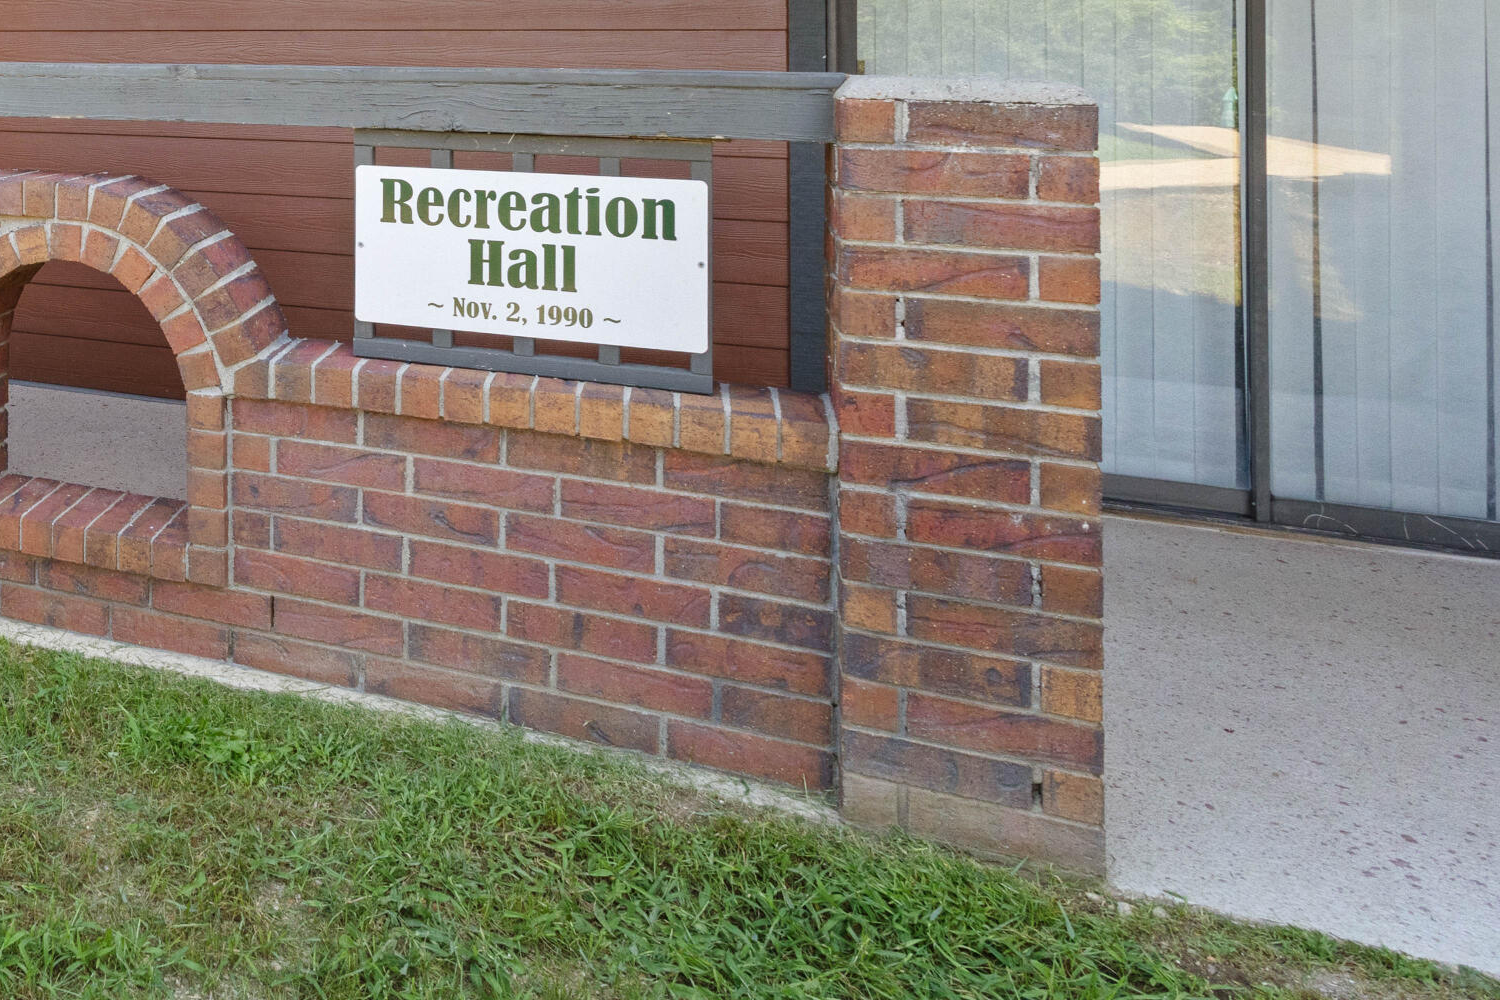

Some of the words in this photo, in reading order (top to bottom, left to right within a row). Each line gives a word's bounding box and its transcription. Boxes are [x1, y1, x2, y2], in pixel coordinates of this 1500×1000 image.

[380, 178, 677, 241] Recreation
[467, 238, 578, 293] Hall
[453, 297, 497, 320] Nov.
[506, 301, 527, 325] 2,
[536, 304, 594, 329] 1990
